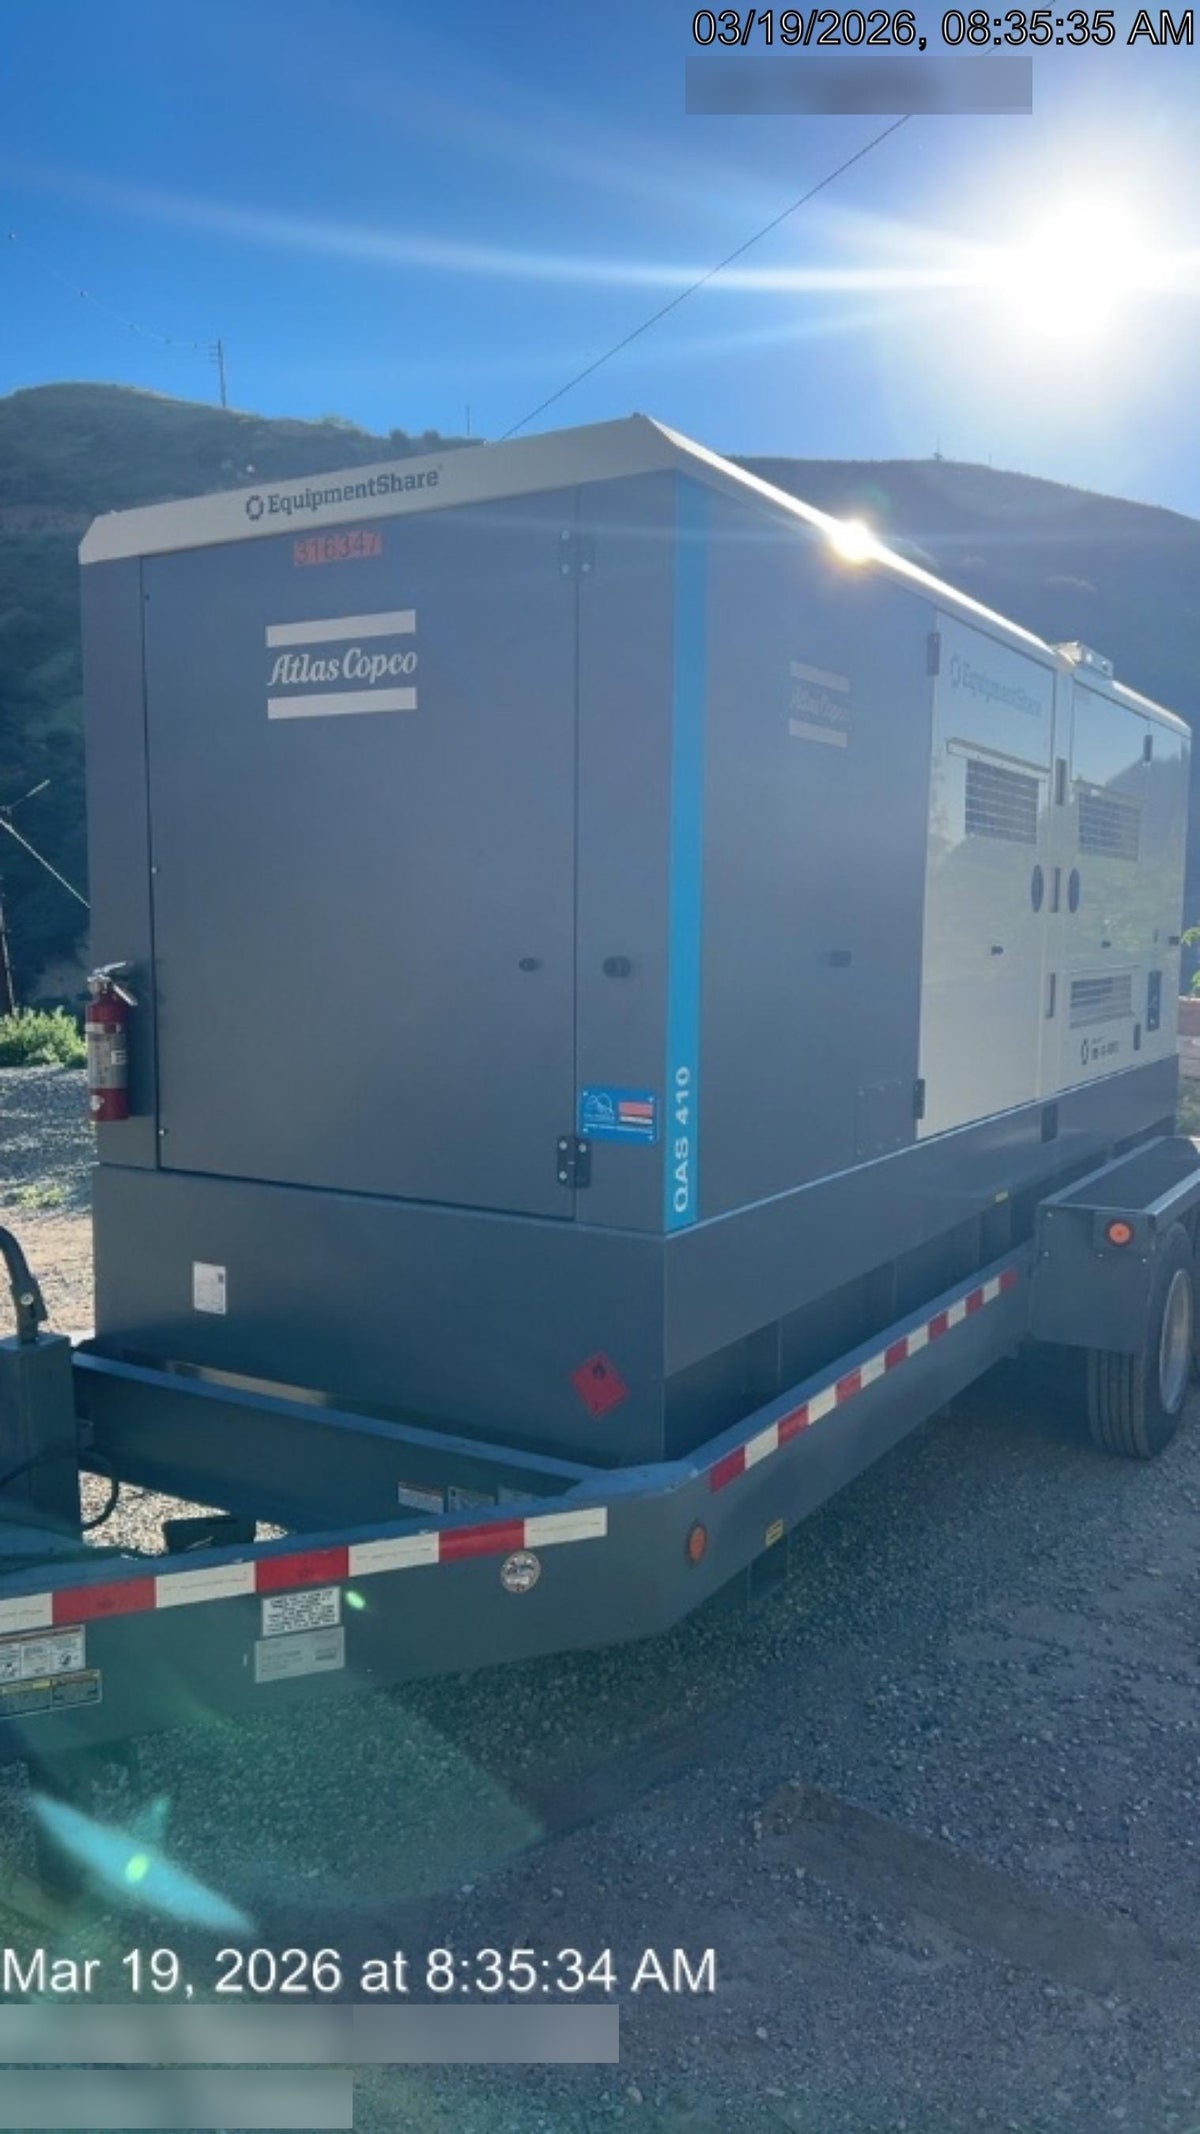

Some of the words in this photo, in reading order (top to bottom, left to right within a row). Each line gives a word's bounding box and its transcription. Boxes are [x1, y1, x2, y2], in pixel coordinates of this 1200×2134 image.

[267, 470, 440, 515] EquipmentShare
[296, 529, 380, 565] 316347
[266, 653, 340, 686] Atlas
[342, 647, 418, 684] Copco
[674, 1065, 691, 1125] 410
[673, 1136, 690, 1213] QAS
